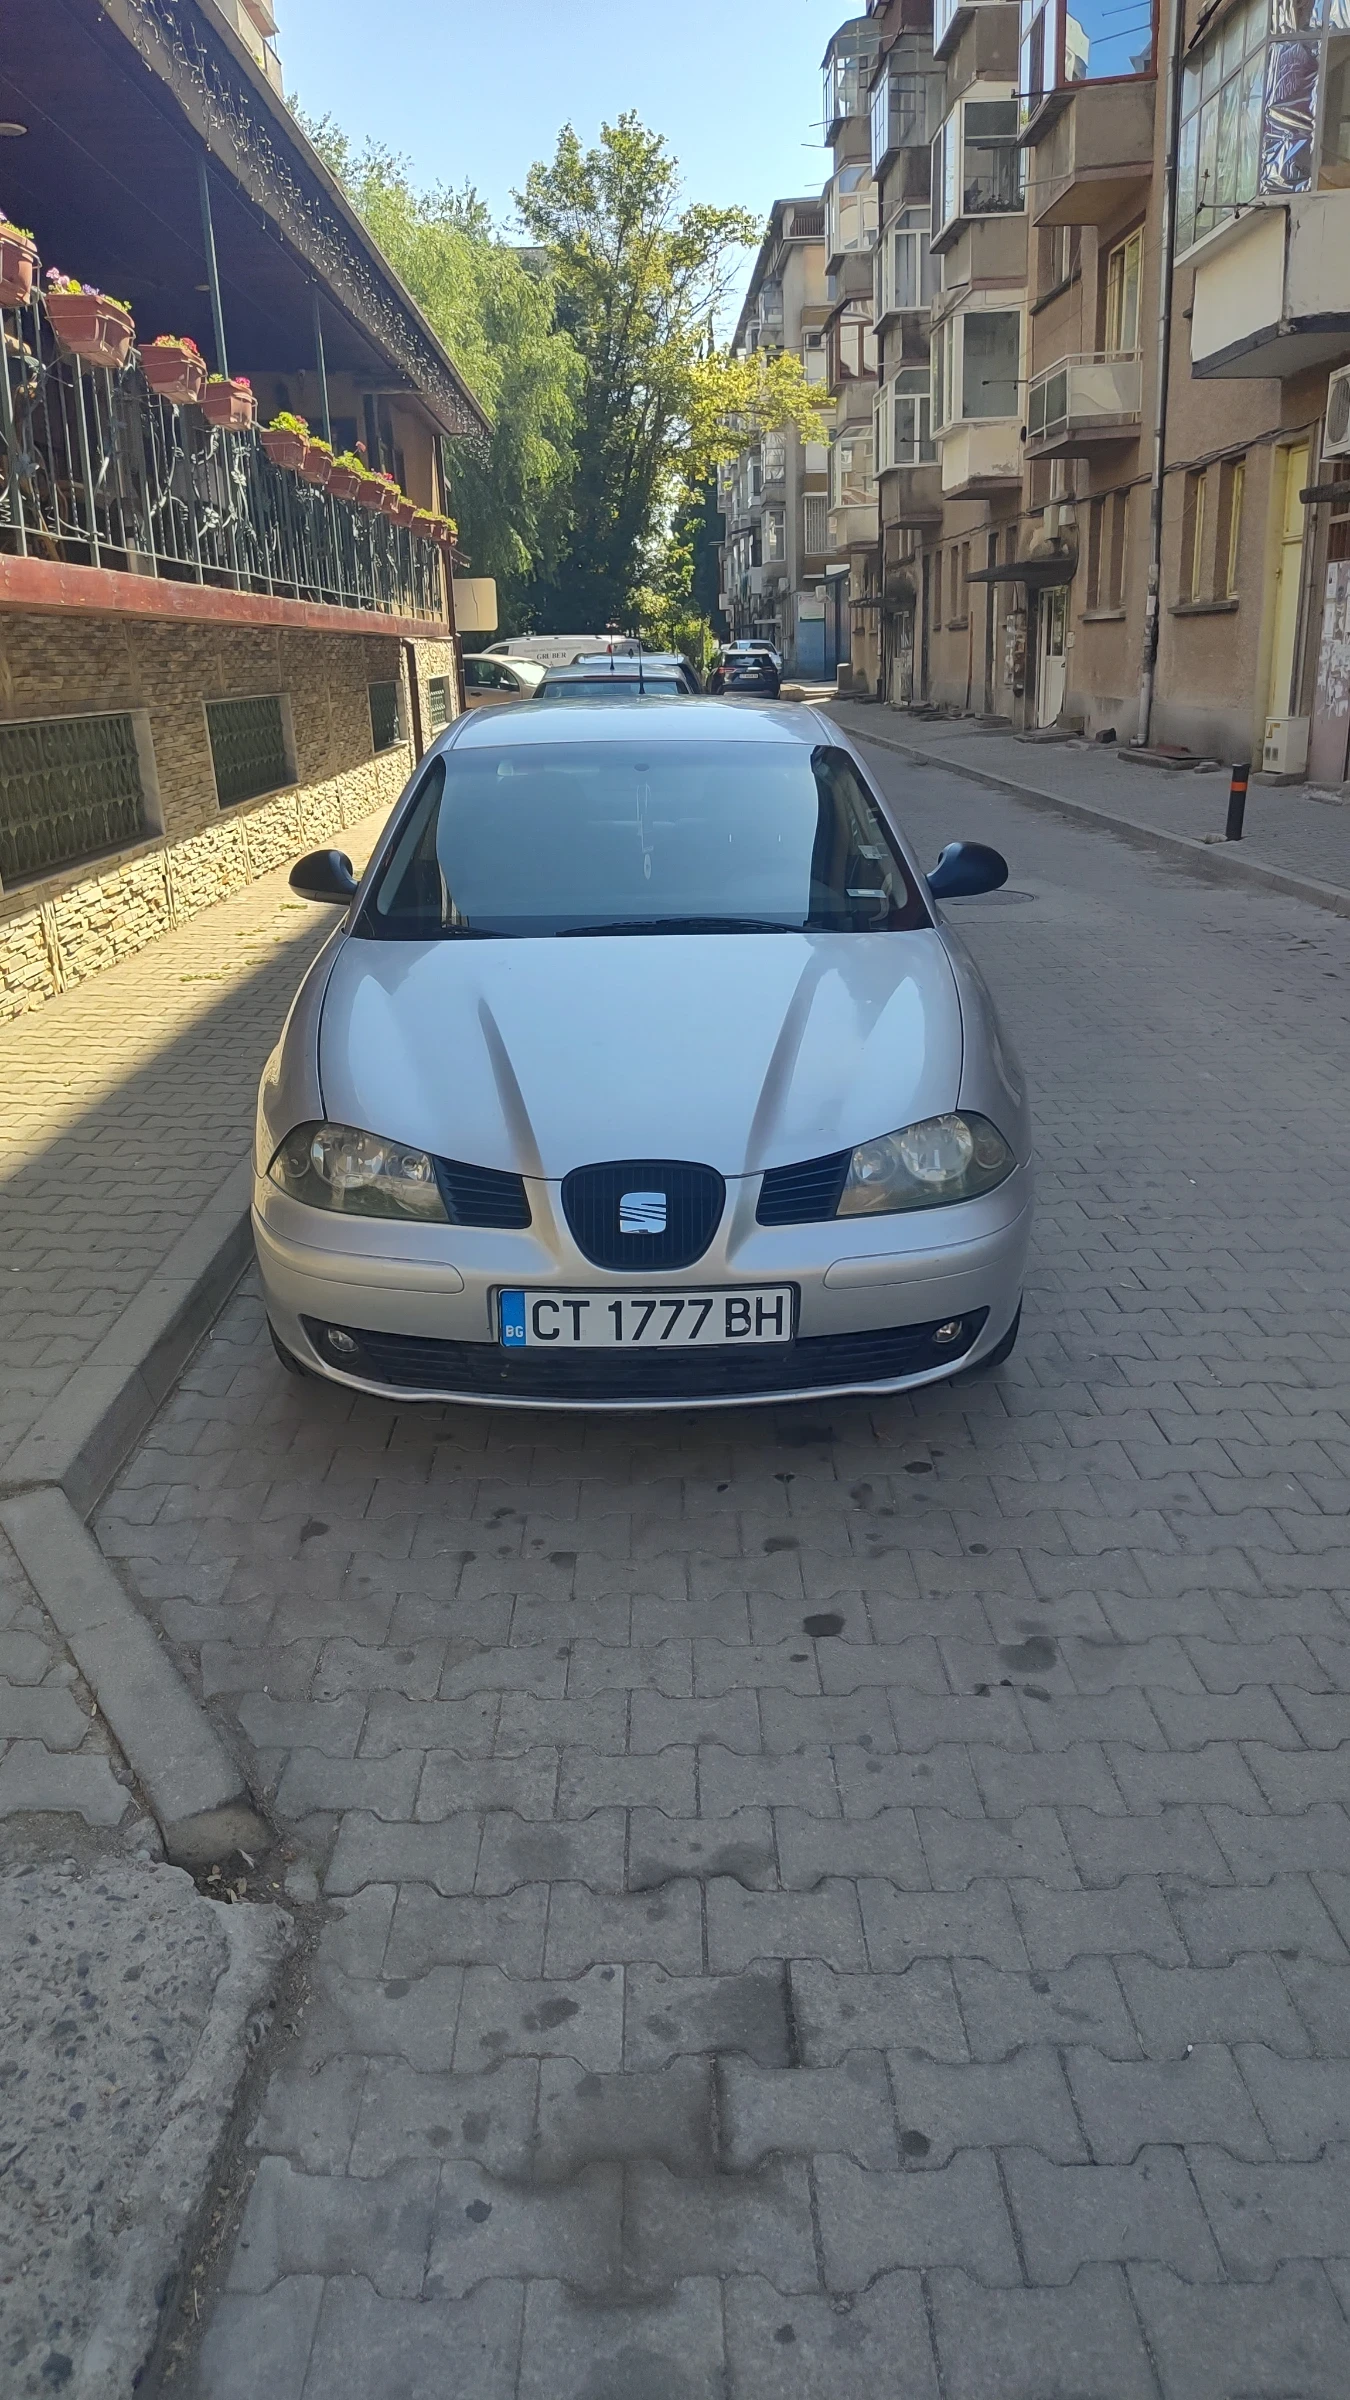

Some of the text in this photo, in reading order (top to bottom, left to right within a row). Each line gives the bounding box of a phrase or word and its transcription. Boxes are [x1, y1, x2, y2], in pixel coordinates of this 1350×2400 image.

[505, 1325, 524, 1338] BG
[532, 1296, 783, 1341] CT 1777 BH
